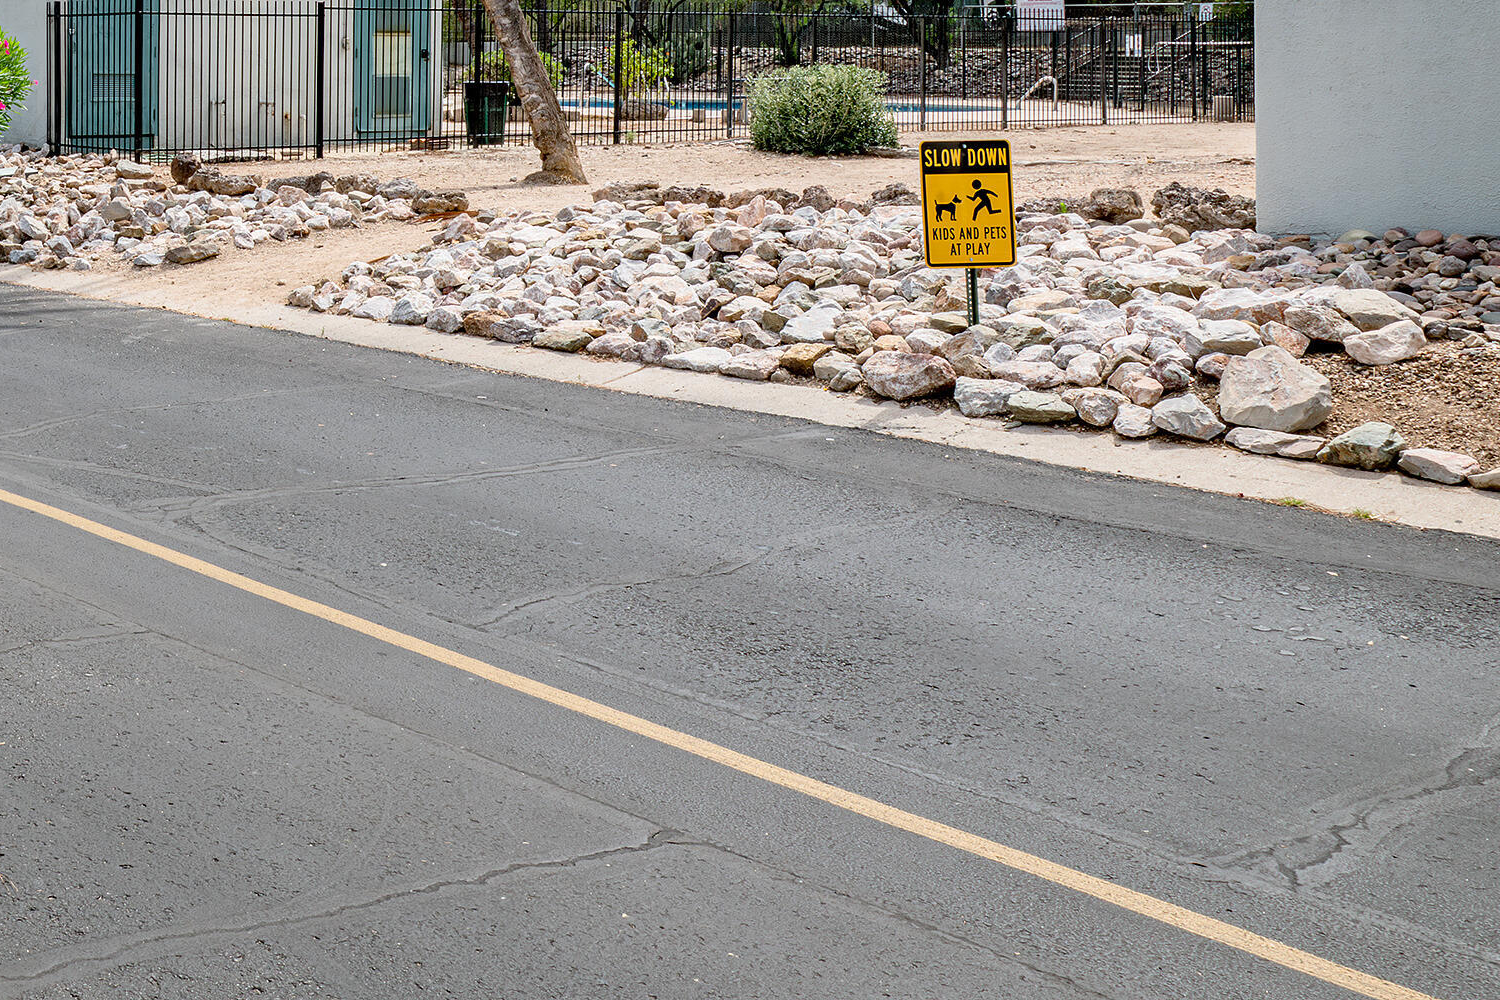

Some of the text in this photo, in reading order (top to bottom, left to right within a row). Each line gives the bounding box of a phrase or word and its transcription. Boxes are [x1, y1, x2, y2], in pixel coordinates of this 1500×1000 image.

[924, 148, 1007, 167] SLOW DOWN
[933, 226, 1007, 240] KIDS AND PETS
[950, 243, 990, 256] AT PLAY
